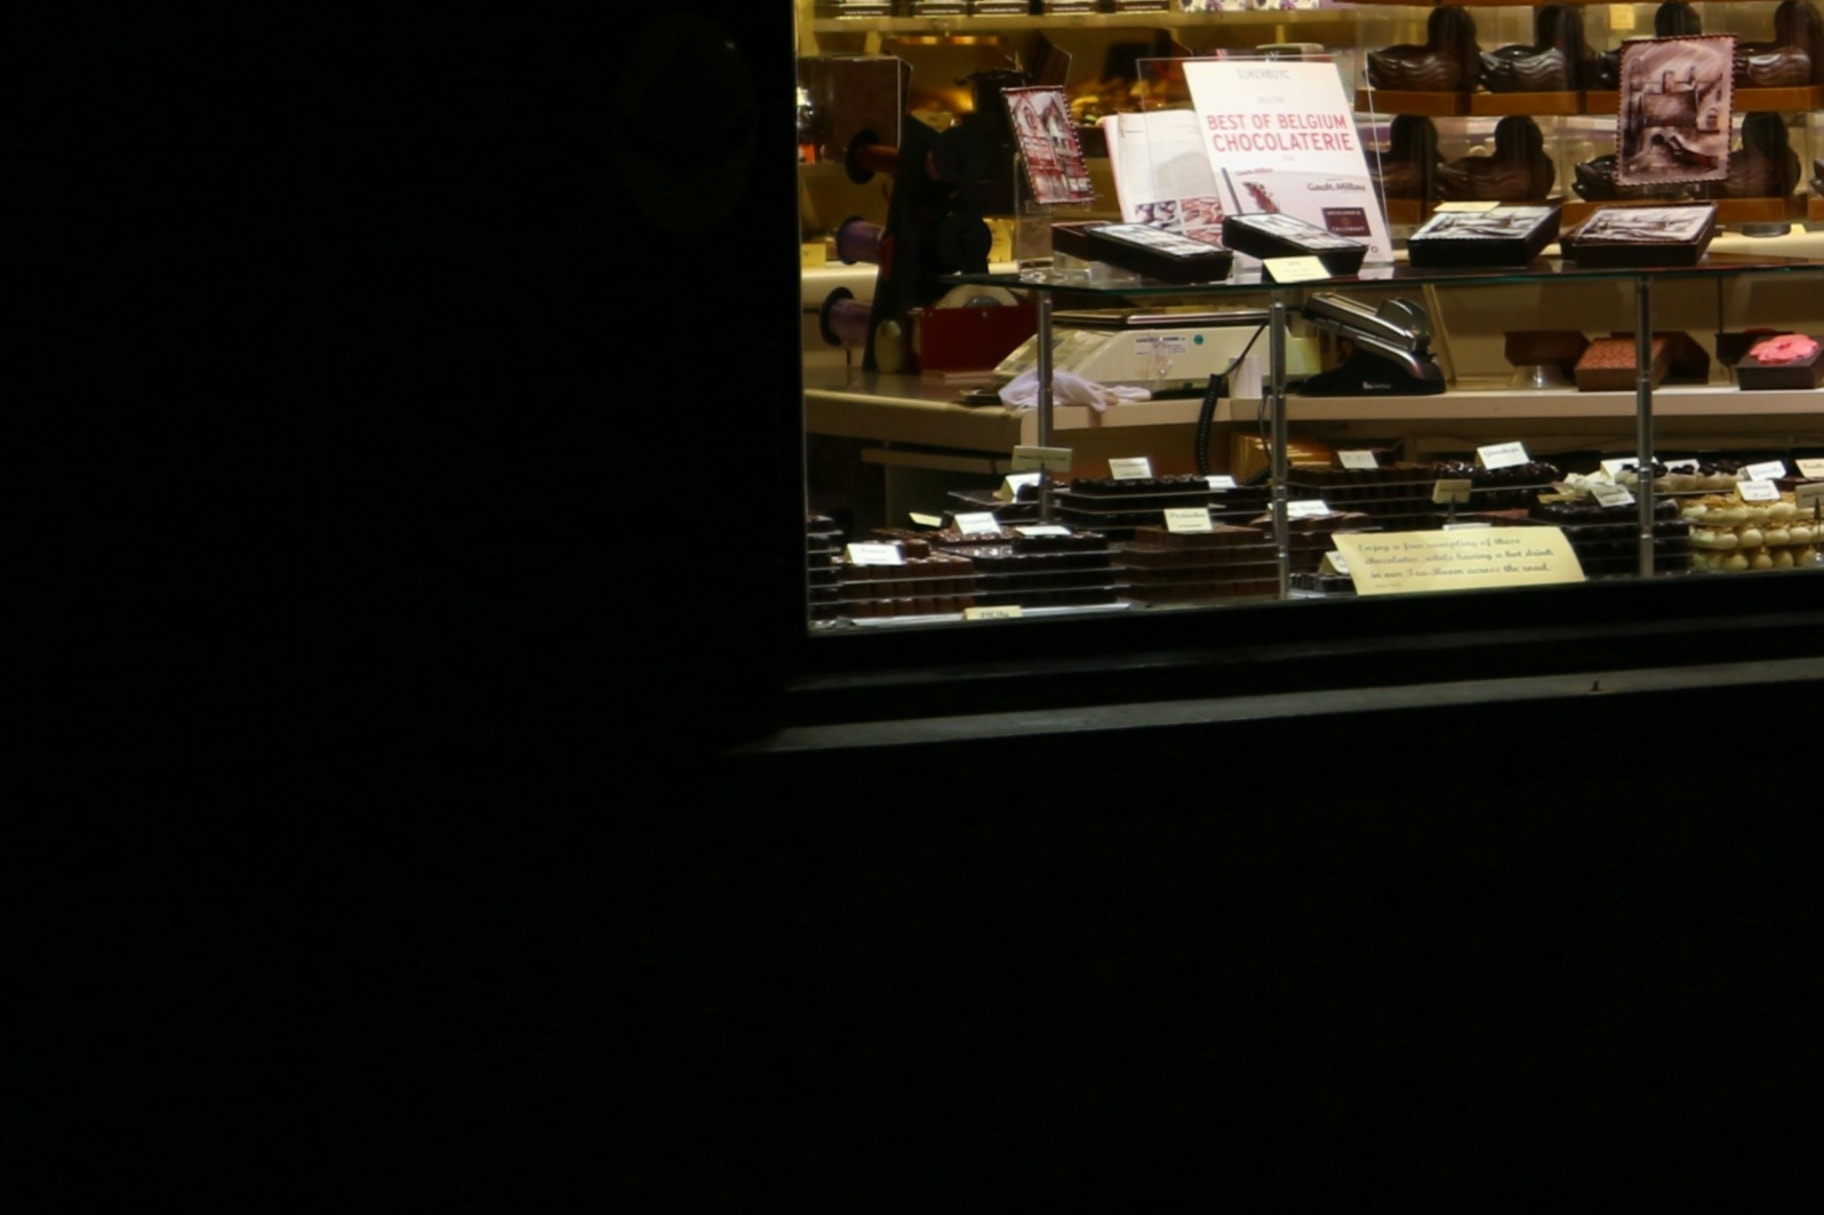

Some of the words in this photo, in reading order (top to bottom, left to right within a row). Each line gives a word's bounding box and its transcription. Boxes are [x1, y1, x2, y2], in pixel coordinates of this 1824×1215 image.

[1207, 115, 1245, 131] BEST
[1253, 115, 1273, 130] OF
[1279, 114, 1347, 130] BELGIUM
[1213, 133, 1354, 153] CHOCOLATERIE
